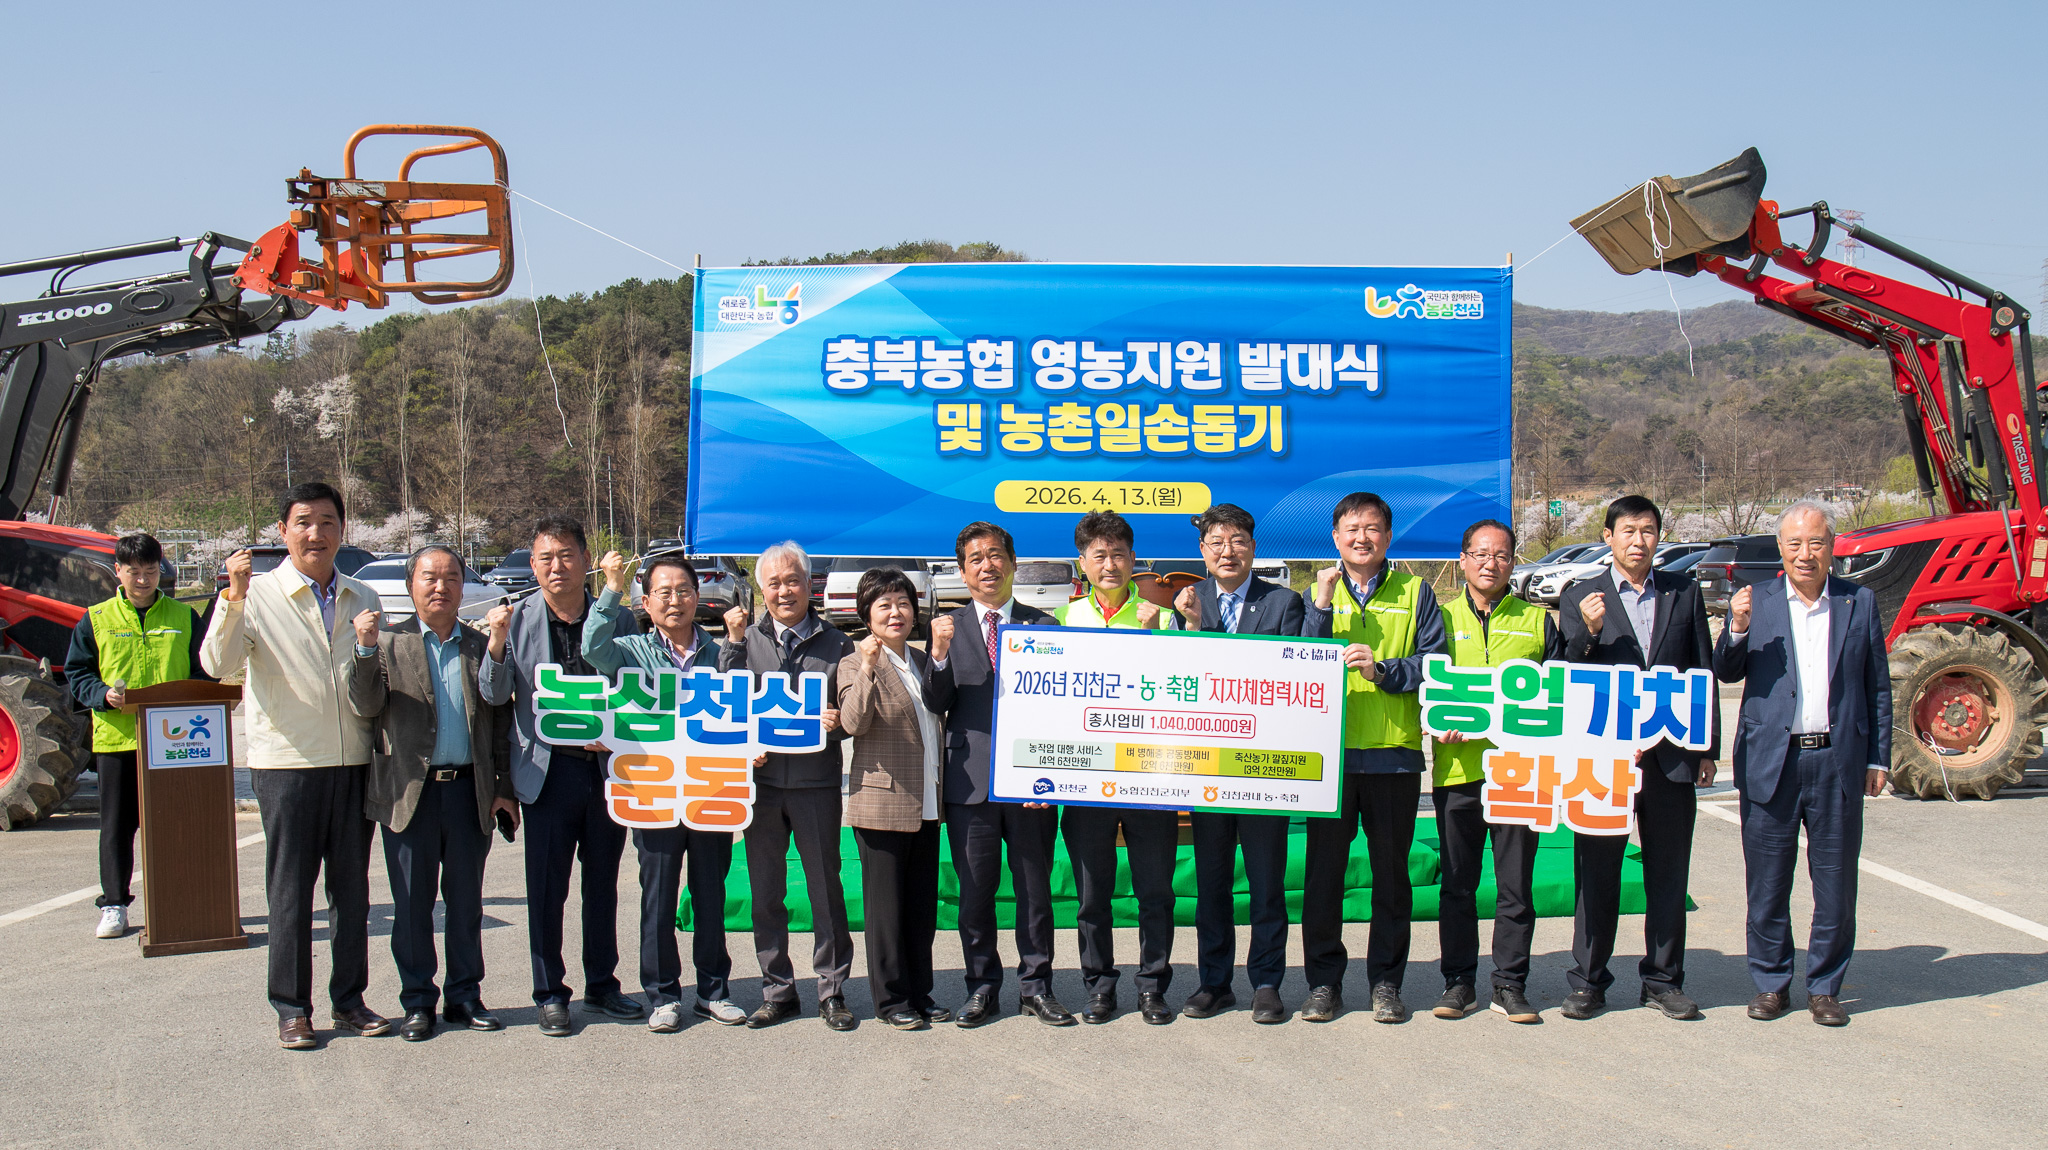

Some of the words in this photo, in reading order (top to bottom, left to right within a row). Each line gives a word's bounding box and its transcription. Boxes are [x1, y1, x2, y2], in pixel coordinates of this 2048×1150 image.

[721, 299, 747, 308] 새로운
[1426, 303, 1482, 317] 농심천심
[17, 302, 113, 327] K1000
[721, 311, 755, 321] 대한민국
[825, 339, 1014, 390] 충북농협
[1031, 339, 1222, 391] 영농지원
[1238, 343, 1379, 392] 발대식
[937, 403, 982, 452] 및
[999, 402, 1283, 453] 농촌일손돕기
[2011, 432, 2033, 485] TAESUNG
[1025, 487, 1087, 505] 2026.
[1091, 487, 1112, 506] 4.
[1119, 487, 1182, 507] 13.(월)
[1036, 646, 1064, 655] 농심천심
[1013, 670, 1068, 697] 2026년
[1072, 671, 1122, 699] 진천군
[537, 669, 823, 748] 농심천심
[1425, 660, 1565, 737] 농업
[1570, 669, 1708, 745] 가치
[1089, 713, 1144, 729] 총사업비
[1150, 716, 1253, 734] 1,040,000,000원
[165, 747, 211, 760] 농심천심
[1029, 743, 1055, 754] 농작업
[1057, 744, 1075, 755] 대행
[1077, 745, 1103, 756] 서비스
[1234, 752, 1270, 764] 축산농가
[611, 753, 750, 826] 운동
[1058, 783, 1088, 794] 진천군
[1487, 751, 1636, 829] 확산
